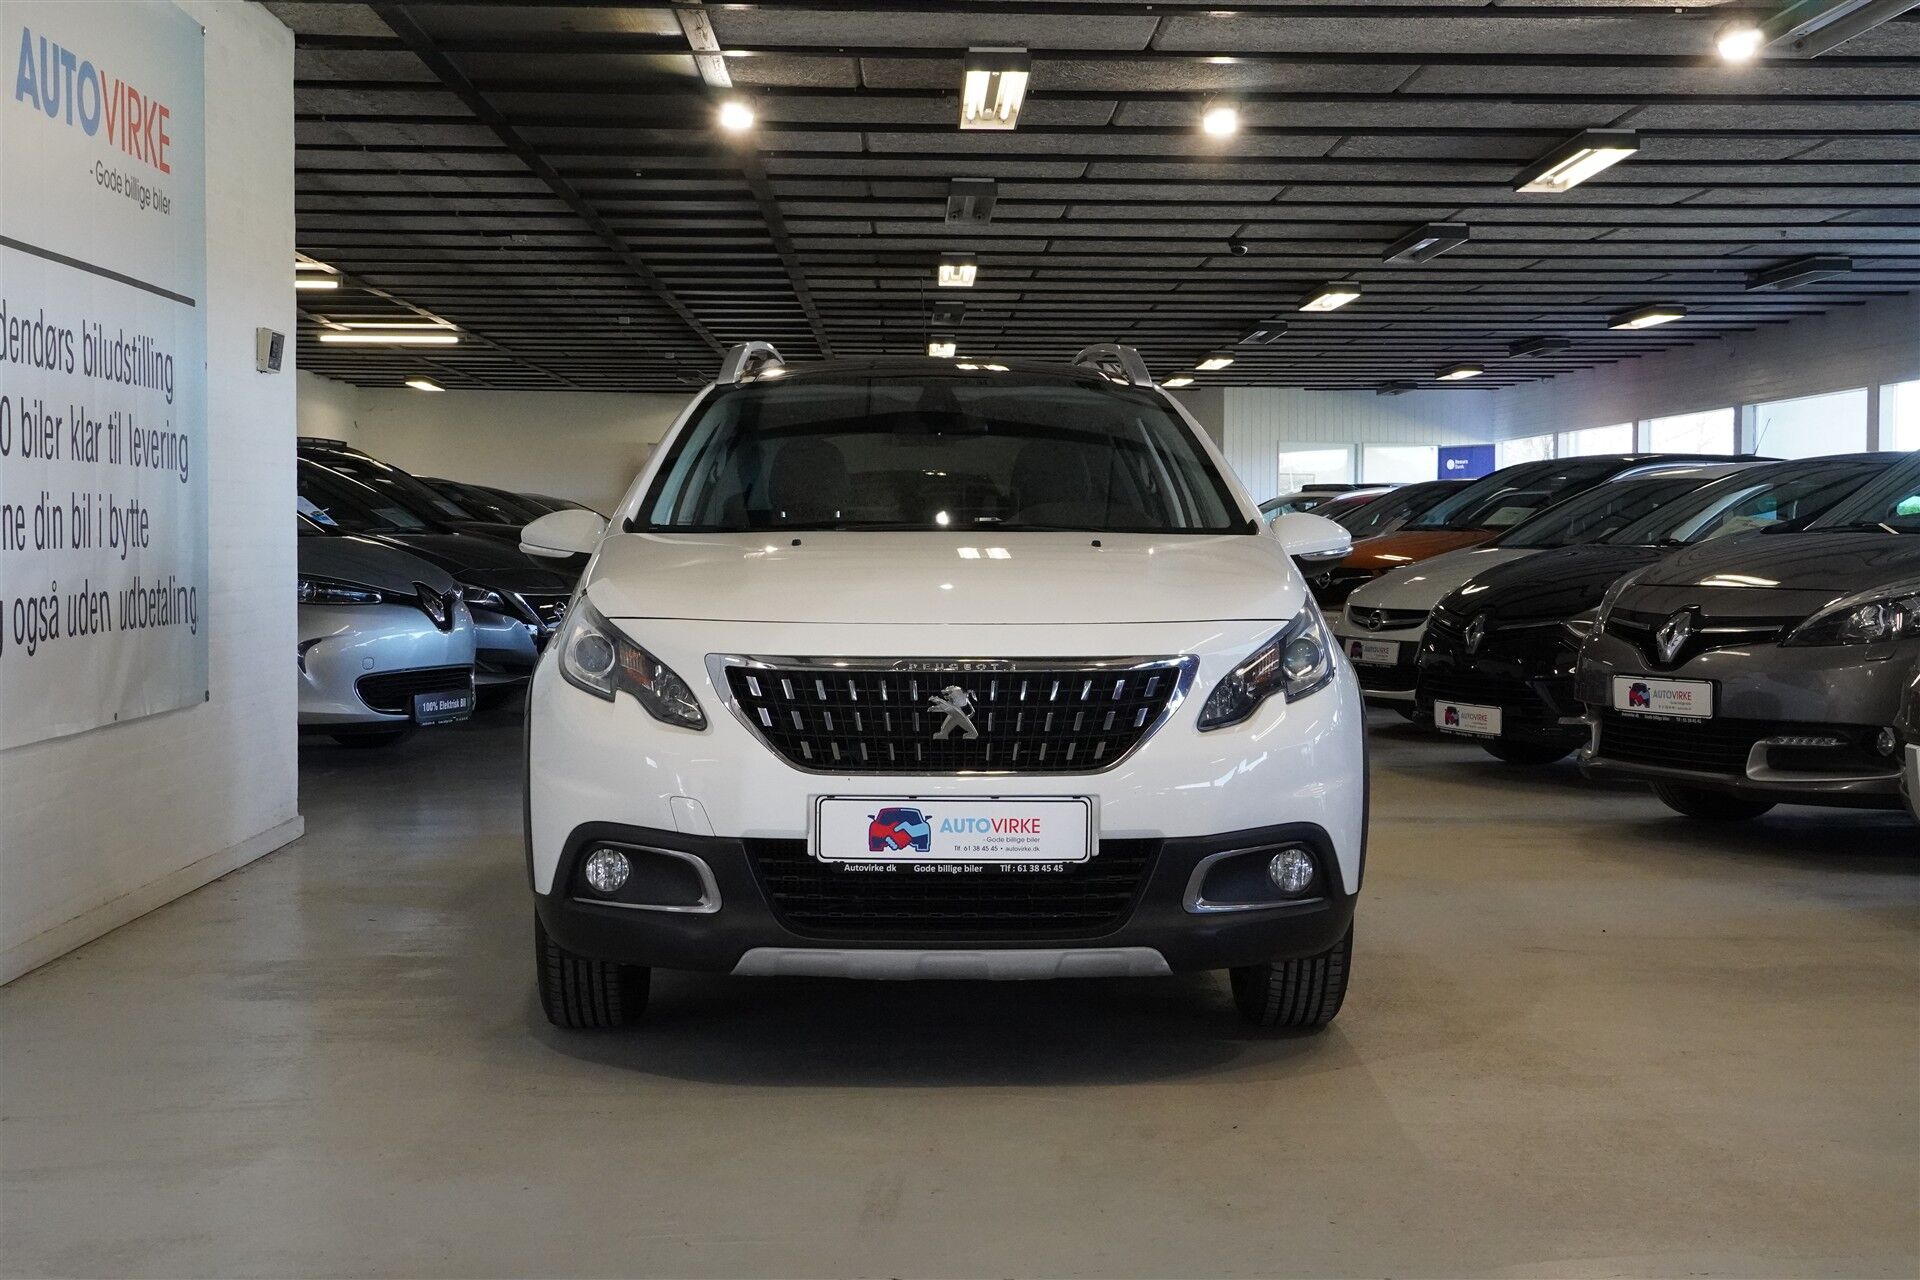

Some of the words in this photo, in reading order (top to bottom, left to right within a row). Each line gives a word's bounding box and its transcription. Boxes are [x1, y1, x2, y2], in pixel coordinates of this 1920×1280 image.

[15, 26, 171, 175] AUTOVIRKE
[96, 160, 123, 194] Gode
[125, 173, 151, 211] billige
[153, 186, 171, 216] biler
[83, 319, 174, 404] biludstilling
[21, 397, 62, 460] biler
[70, 405, 102, 463] klar
[108, 411, 122, 465] til
[129, 414, 189, 482] levering
[35, 491, 63, 550] din
[72, 492, 91, 550] bil
[98, 494, 102, 548] i
[110, 494, 149, 560] bytte
[14, 581, 60, 656] også
[68, 579, 112, 638] uden
[423, 702, 438, 712] 100%
[1652, 690, 1692, 701] AUTOVIRKE
[940, 818, 1041, 834] AUTOVIRKE
[914, 864, 936, 873] Gode
[937, 864, 962, 875] billige
[964, 864, 984, 873] biler
[1000, 864, 1011, 873] Tlf
[1017, 864, 1028, 873] 61
[1029, 864, 1040, 873] 38
[1041, 864, 1052, 873] 45
[1053, 864, 1064, 873] 45
